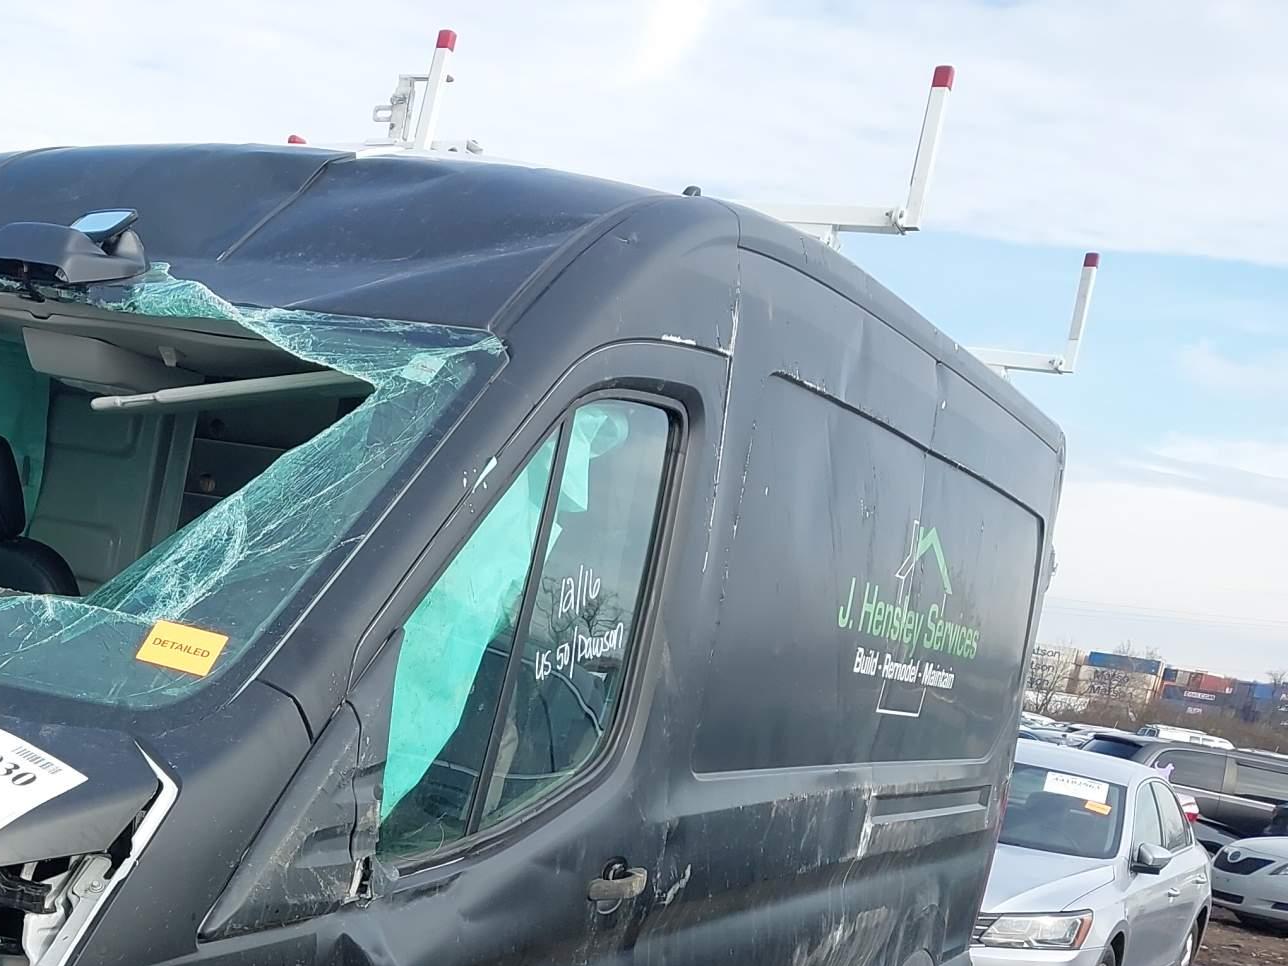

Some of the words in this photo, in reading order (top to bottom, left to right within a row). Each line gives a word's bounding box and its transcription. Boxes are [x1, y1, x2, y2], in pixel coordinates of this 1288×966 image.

[558, 564, 601, 619] 12/16
[858, 582, 925, 658] Hensley
[923, 603, 980, 660] Services
[152, 637, 210, 658] DETAILED
[535, 650, 552, 680] US
[853, 647, 880, 676] Build
[881, 653, 920, 684] Remodel
[921, 662, 955, 689] Maintain
